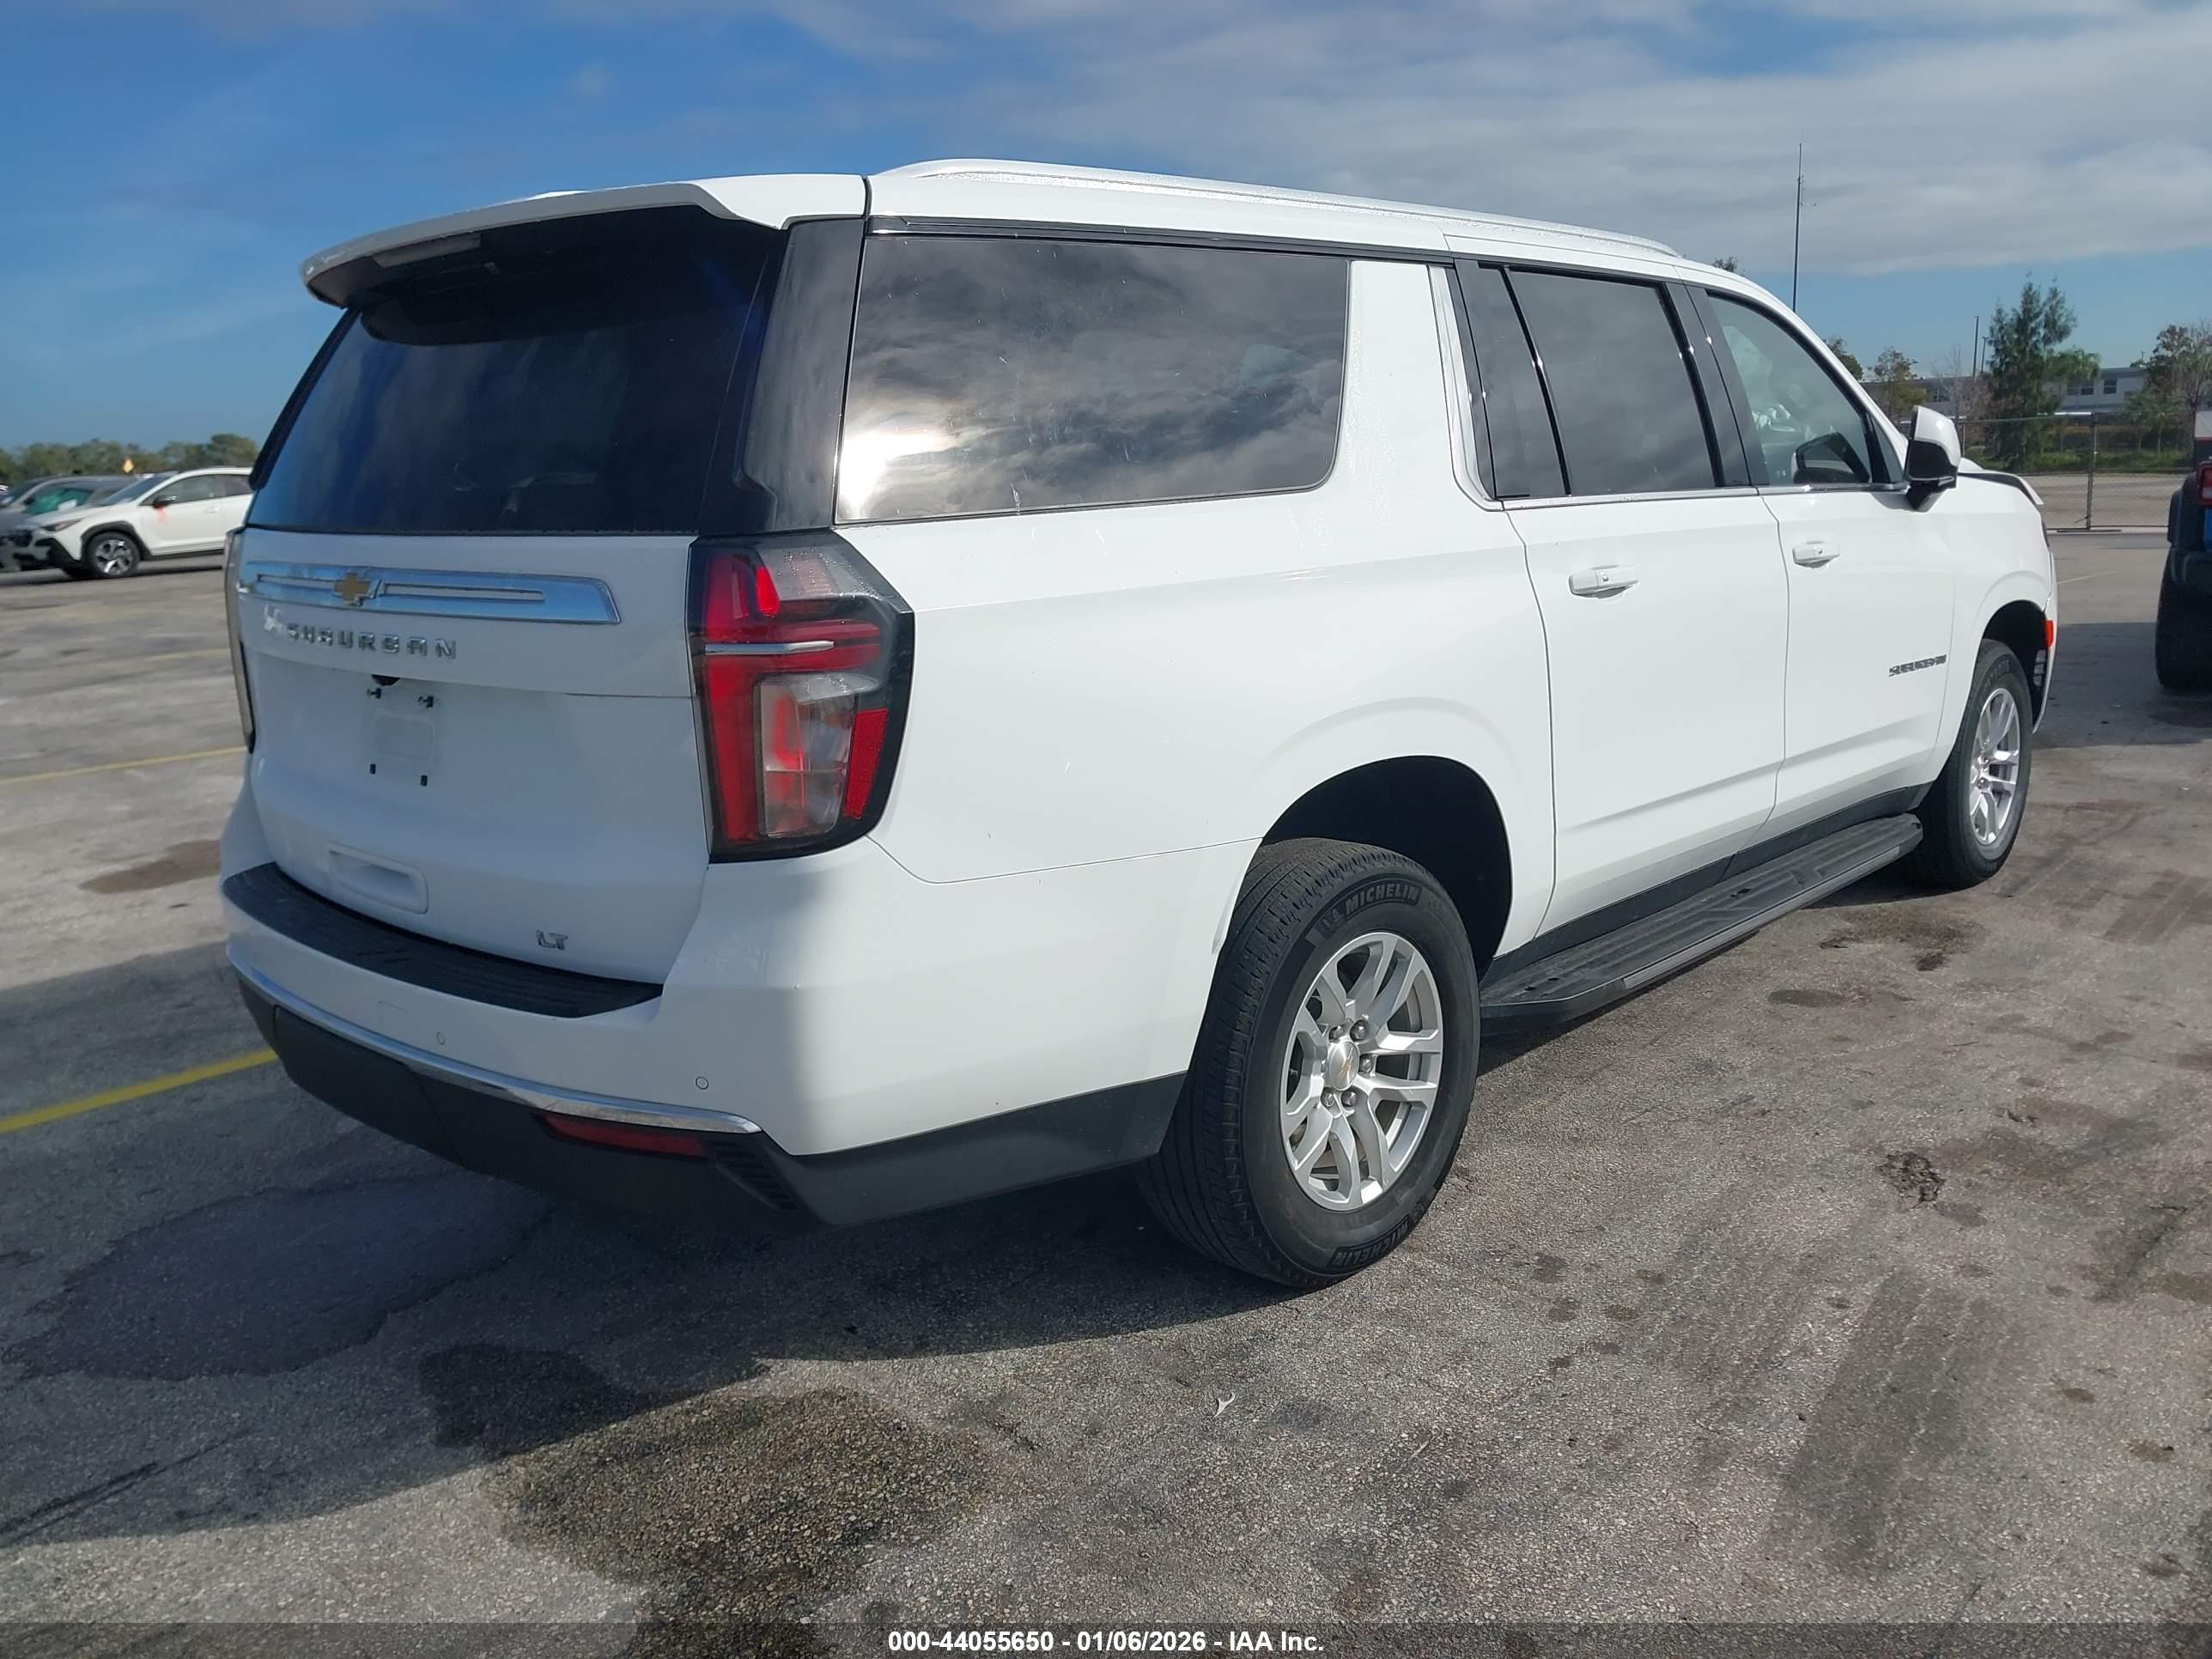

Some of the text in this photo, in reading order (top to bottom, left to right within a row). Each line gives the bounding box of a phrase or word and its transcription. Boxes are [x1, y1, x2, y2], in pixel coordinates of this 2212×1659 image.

[287, 623, 457, 659] SUBURBAN
[1346, 883, 1419, 915] MICHELIN
[536, 929, 568, 951] LT
